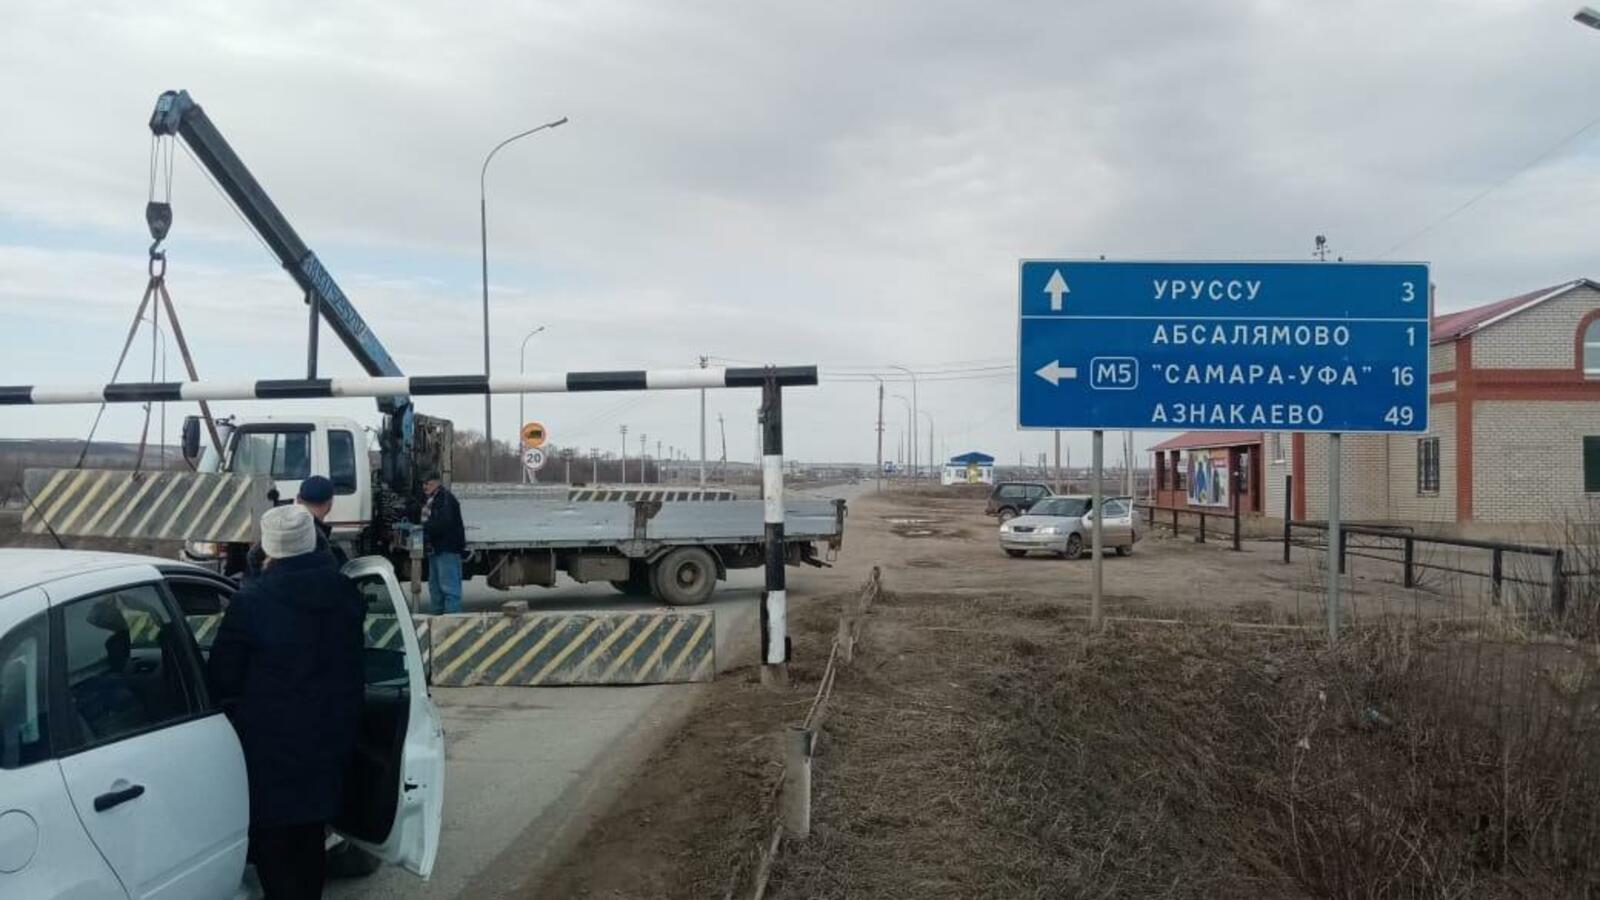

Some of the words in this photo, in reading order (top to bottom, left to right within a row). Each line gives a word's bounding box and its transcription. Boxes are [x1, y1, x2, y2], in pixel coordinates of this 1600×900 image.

[1153, 280, 1262, 301] УРУССУ
[1401, 282, 1415, 302] 3
[1152, 325, 1350, 346] АБСАЛЯМОВО
[1406, 327, 1415, 346] 1
[1152, 364, 1372, 386] "САМАРА-УФА"
[1391, 366, 1414, 386] 16
[1151, 404, 1324, 425] АЗНАКАЕВО
[1384, 406, 1414, 426] 49
[527, 452, 542, 464] 20
